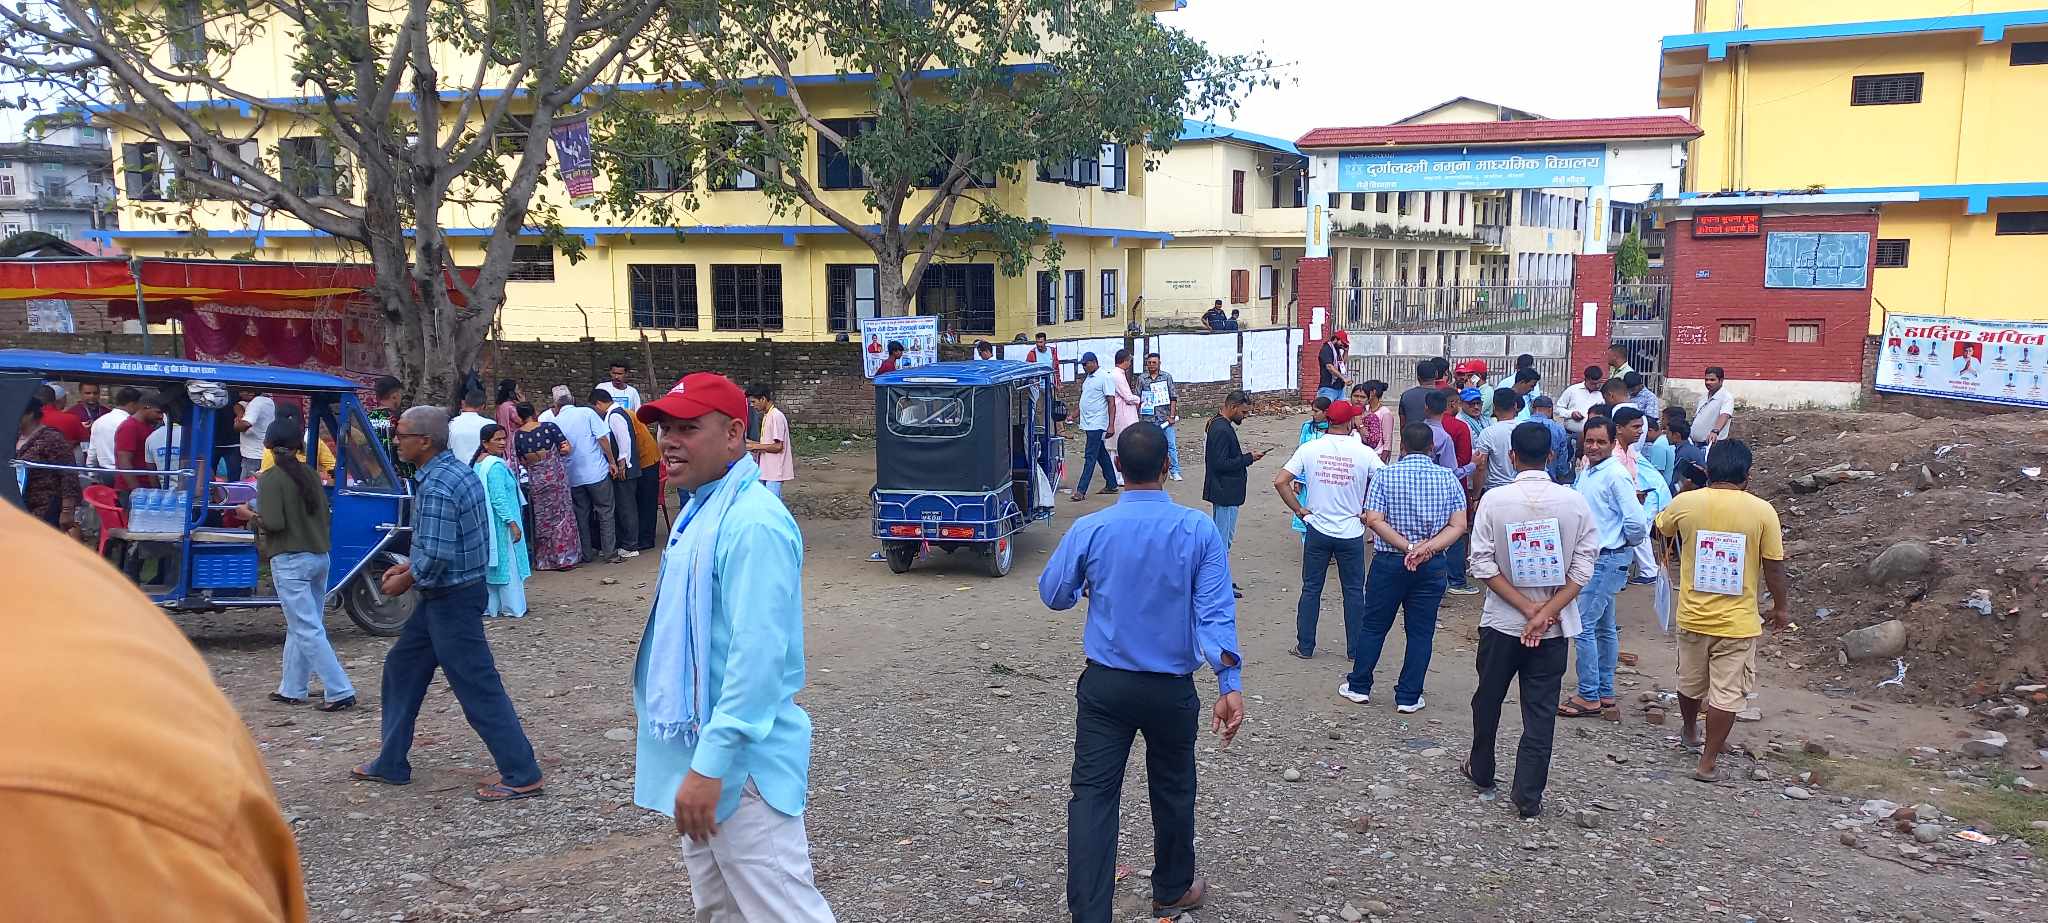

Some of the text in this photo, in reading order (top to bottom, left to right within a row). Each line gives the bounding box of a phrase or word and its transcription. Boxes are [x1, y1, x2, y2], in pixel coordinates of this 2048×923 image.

[1367, 159, 1428, 177] दुर्गालक्ष्मी
[1476, 156, 1541, 171] माध्यमिक
[1545, 154, 1600, 169] विद्यालय
[1904, 325, 2047, 346] हार्दिक अपिल
